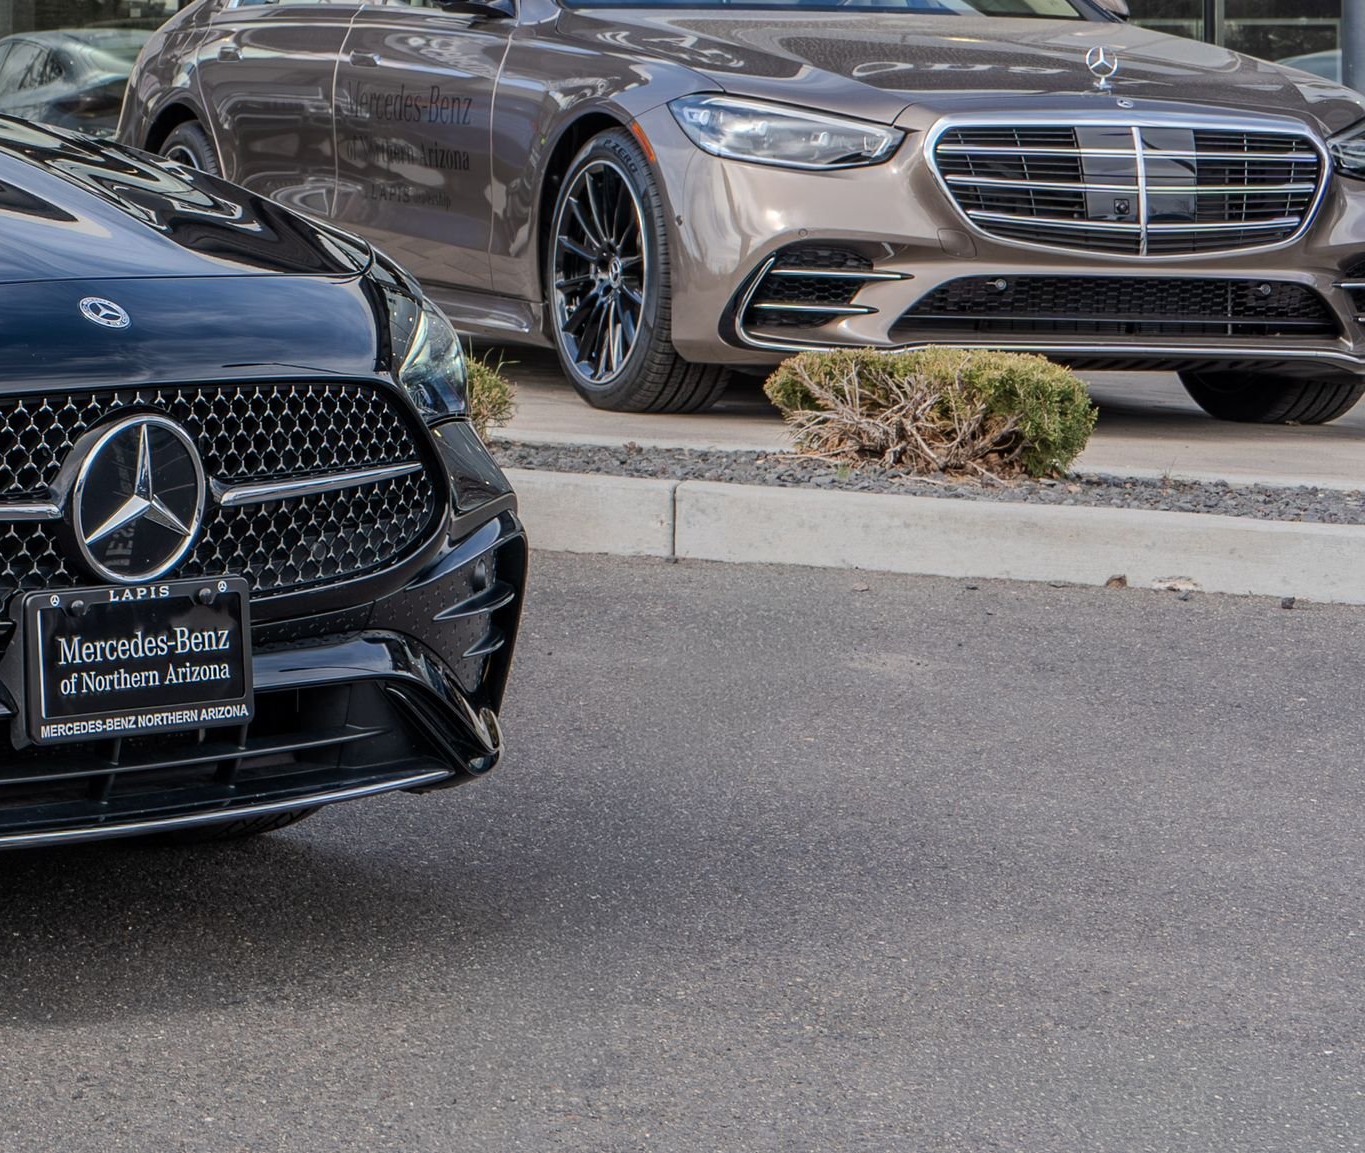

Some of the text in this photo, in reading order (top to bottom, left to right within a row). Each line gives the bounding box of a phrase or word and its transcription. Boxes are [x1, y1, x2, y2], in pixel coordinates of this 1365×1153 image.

[347, 80, 473, 126] Mercedes-Benz
[419, 141, 470, 171] Arizona
[611, 142, 639, 174] ZERO
[371, 184, 410, 203] LAPIS
[109, 585, 170, 602] LAPIS
[58, 627, 230, 665] Mercedes-Benz
[60, 662, 231, 695] of Northern Arizona
[41, 703, 249, 738] MERCEDES-BENZ NORTHERN ARIZONA
